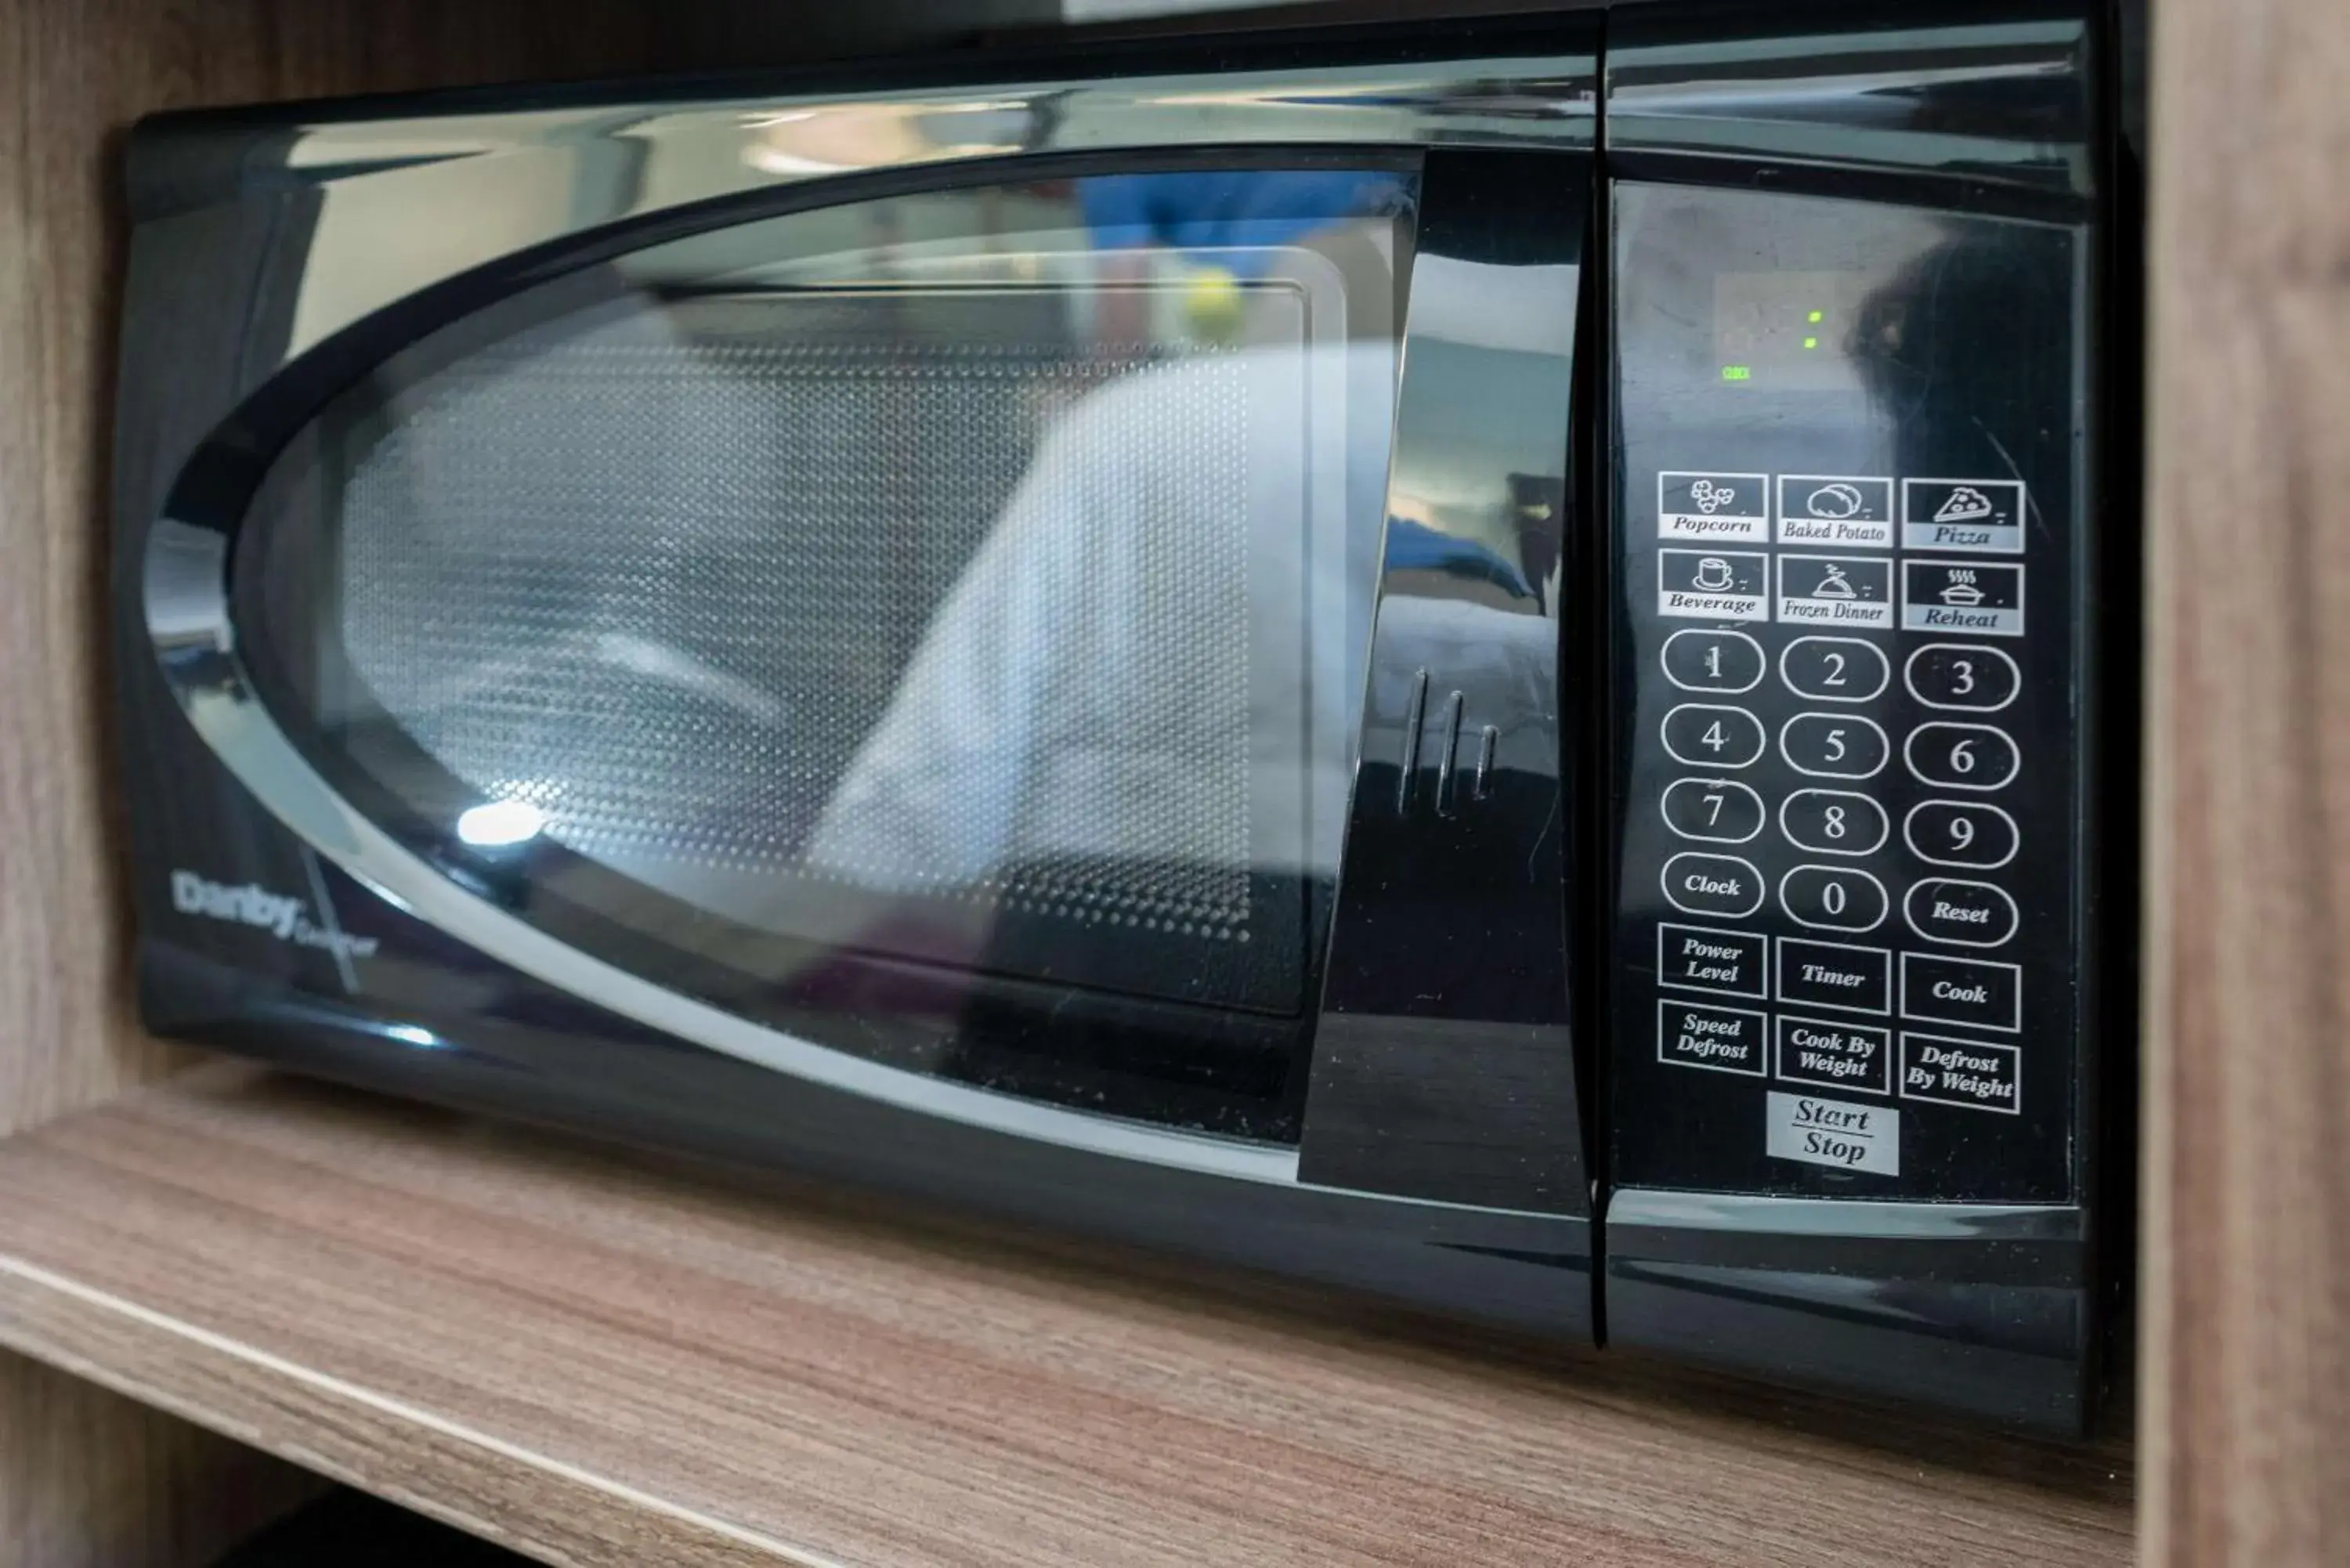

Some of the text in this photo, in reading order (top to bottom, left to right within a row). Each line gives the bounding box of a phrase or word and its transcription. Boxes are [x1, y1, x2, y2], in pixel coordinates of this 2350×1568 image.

[1672, 516, 1752, 534] Popcorn
[1784, 522, 1885, 540] Baked Potato
[1933, 526, 1990, 545] Pizza
[1668, 594, 1756, 612] Beverage
[1784, 601, 1883, 620] Frozen Dinner
[1925, 608, 1998, 628] Reheat
[1705, 646, 1722, 677] 1
[1822, 653, 1846, 685] 2
[1951, 661, 1974, 694] 3
[1701, 721, 1723, 751] 4
[1824, 730, 1846, 761] 5
[1950, 740, 1974, 772] 6
[1702, 796, 1724, 826] 7
[1824, 806, 1846, 839] 8
[1950, 818, 1974, 850] 9
[1684, 874, 1741, 896] Clock
[1823, 883, 1846, 914] 0
[1932, 901, 1990, 923] Reset
[1683, 939, 1743, 960] Power
[1686, 962, 1739, 982] Level
[1802, 965, 1865, 987] Timer
[1932, 981, 1988, 1003] Cook
[1683, 1013, 1741, 1037] Speed
[1677, 1035, 1748, 1060] Defrost
[1791, 1029, 1876, 1057] Cook By
[1801, 1053, 1867, 1077] Weight
[1922, 1046, 1999, 1073] Defrost
[1907, 1068, 2013, 1098] By Weight
[1794, 1100, 1870, 1129] Start
[1805, 1133, 1866, 1165] Stop
